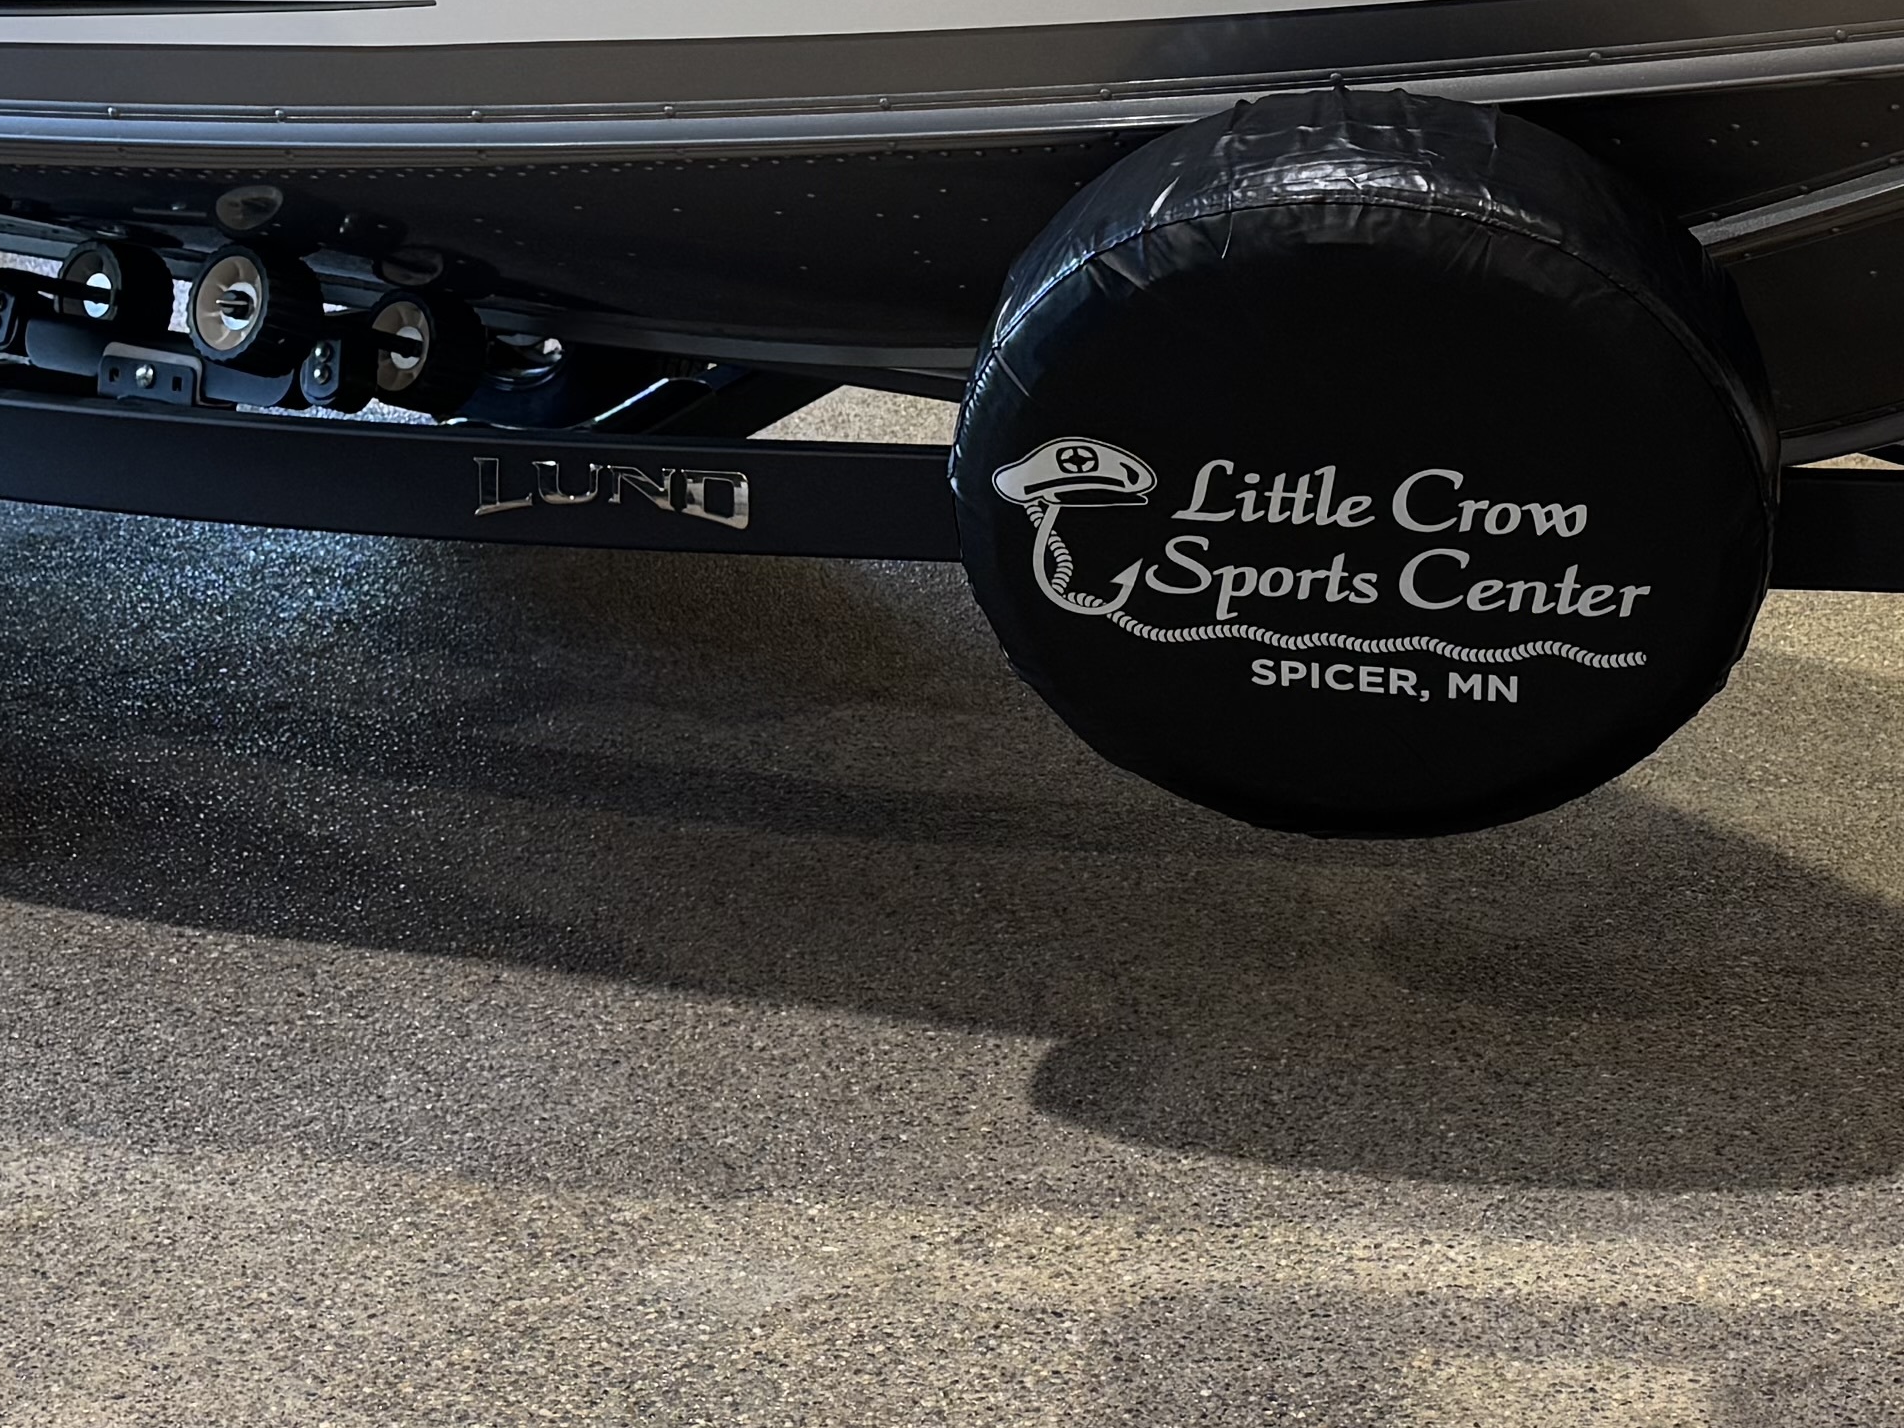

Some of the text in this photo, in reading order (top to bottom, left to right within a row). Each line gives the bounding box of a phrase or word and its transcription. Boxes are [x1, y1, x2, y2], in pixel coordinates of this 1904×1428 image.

[474, 456, 750, 531] LUND
[1171, 459, 1588, 538] Little Crow
[1145, 535, 1652, 620] Sports Center
[1251, 658, 1519, 703] SPICER, MN
